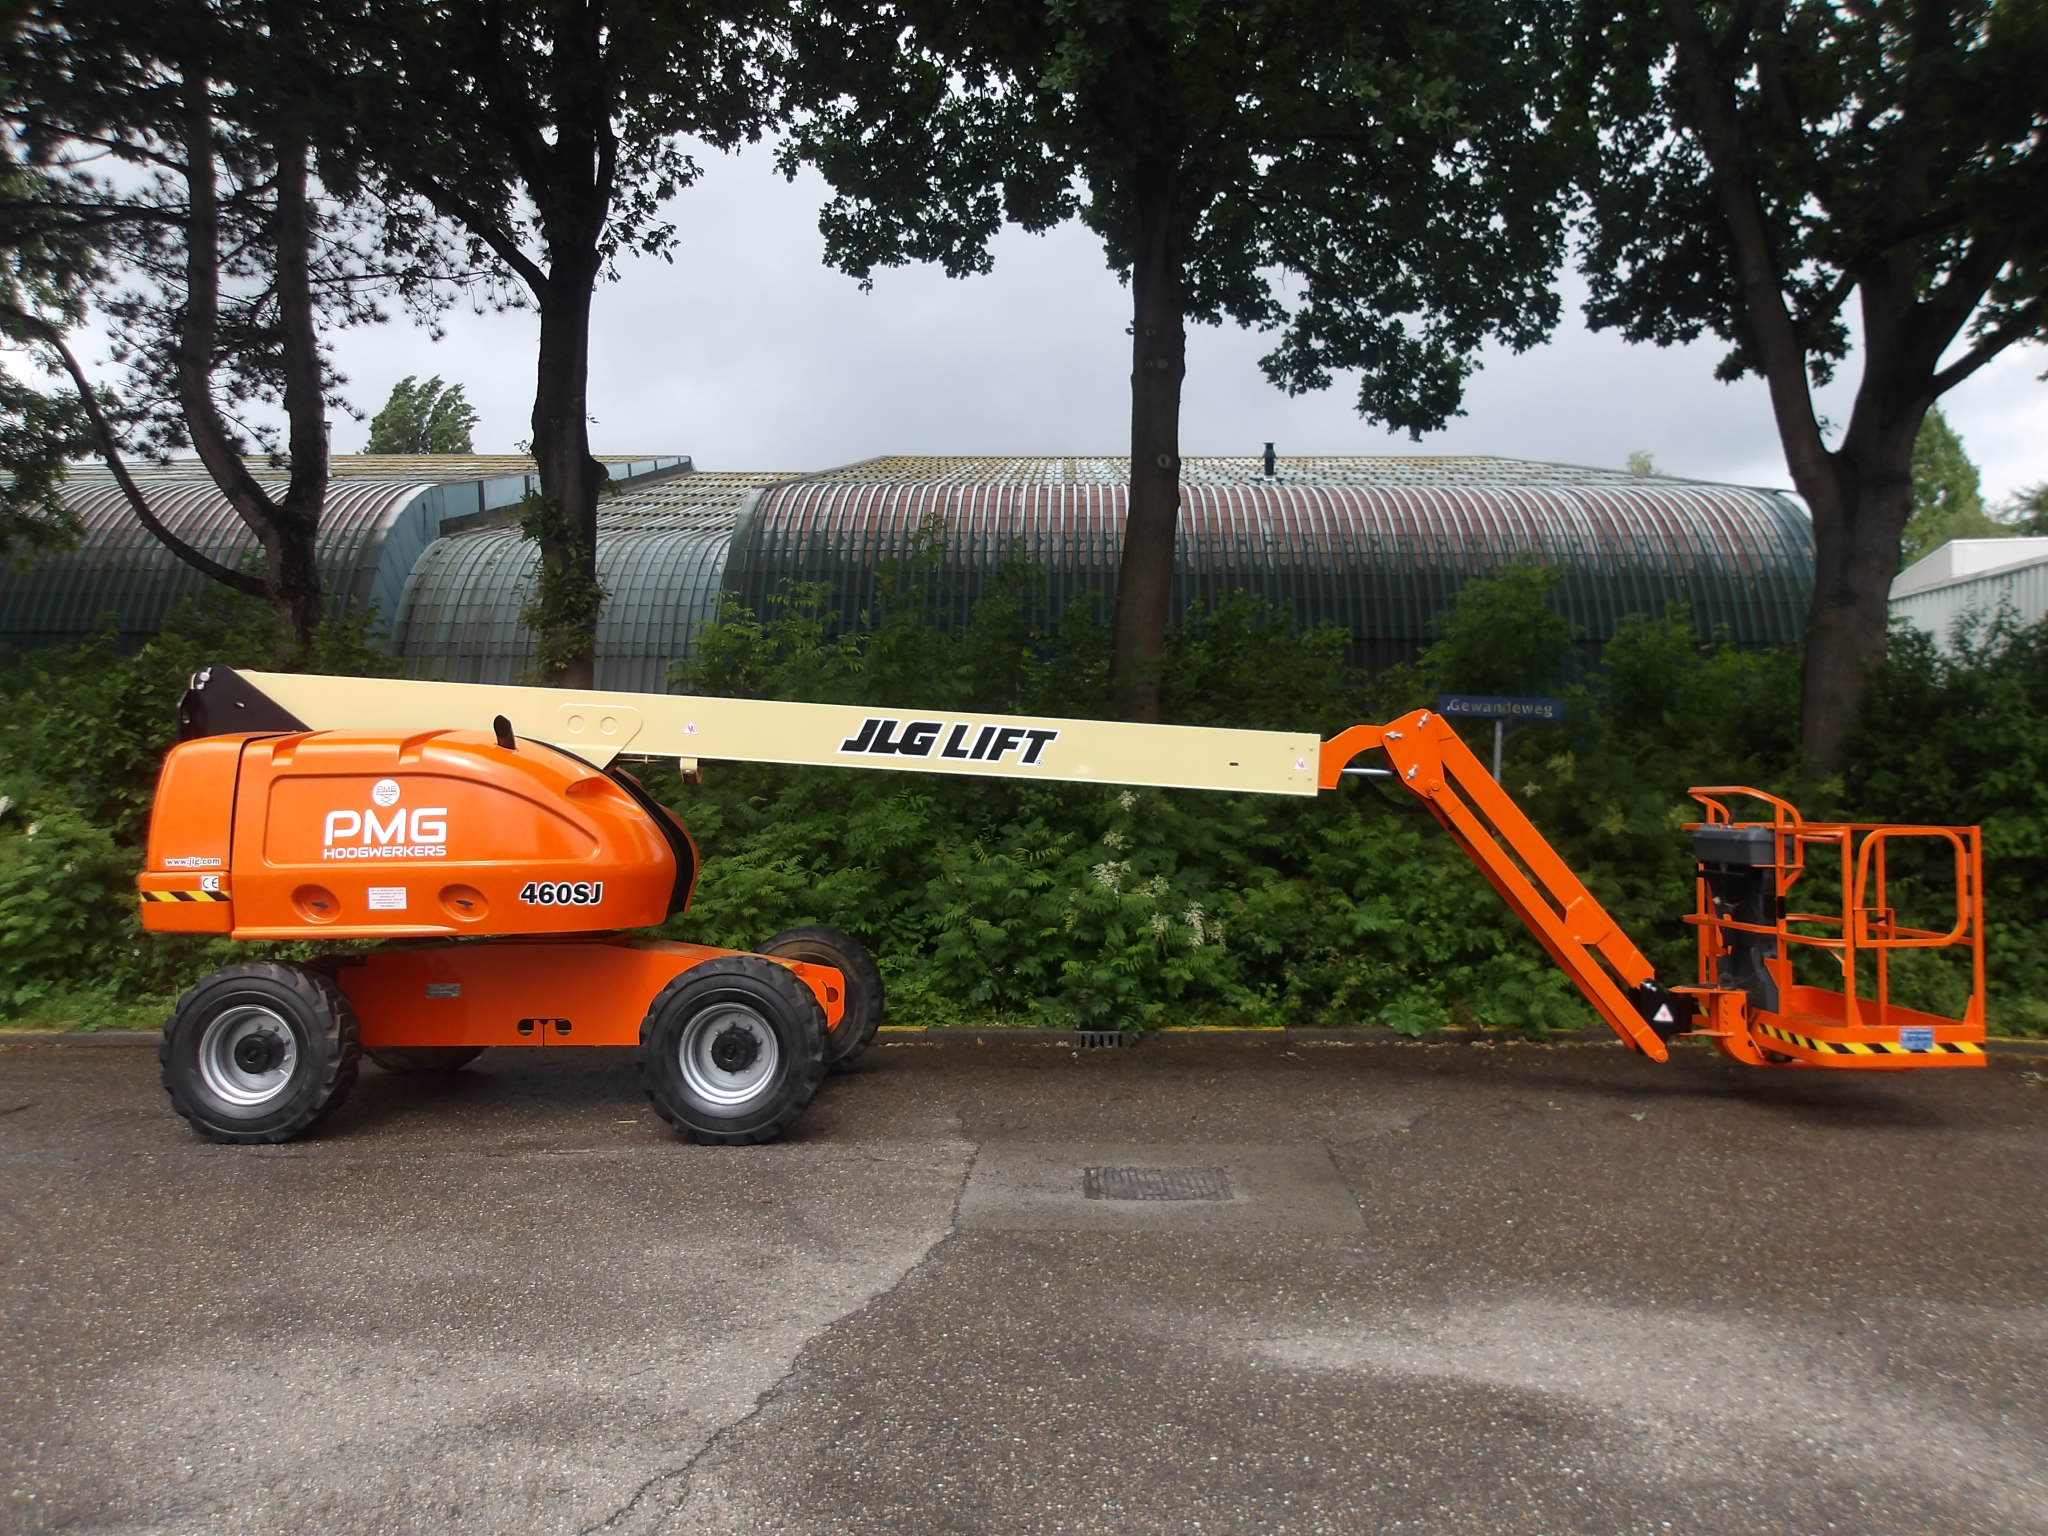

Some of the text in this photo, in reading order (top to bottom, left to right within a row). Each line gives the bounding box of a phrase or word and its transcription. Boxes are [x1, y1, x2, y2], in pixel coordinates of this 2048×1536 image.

[839, 718, 1059, 764] JLG LIFT
[324, 807, 448, 846] PMG
[165, 856, 221, 867] www.jlg.com
[323, 845, 447, 860] HOOGWERKERS
[520, 882, 603, 905] 460SJ
